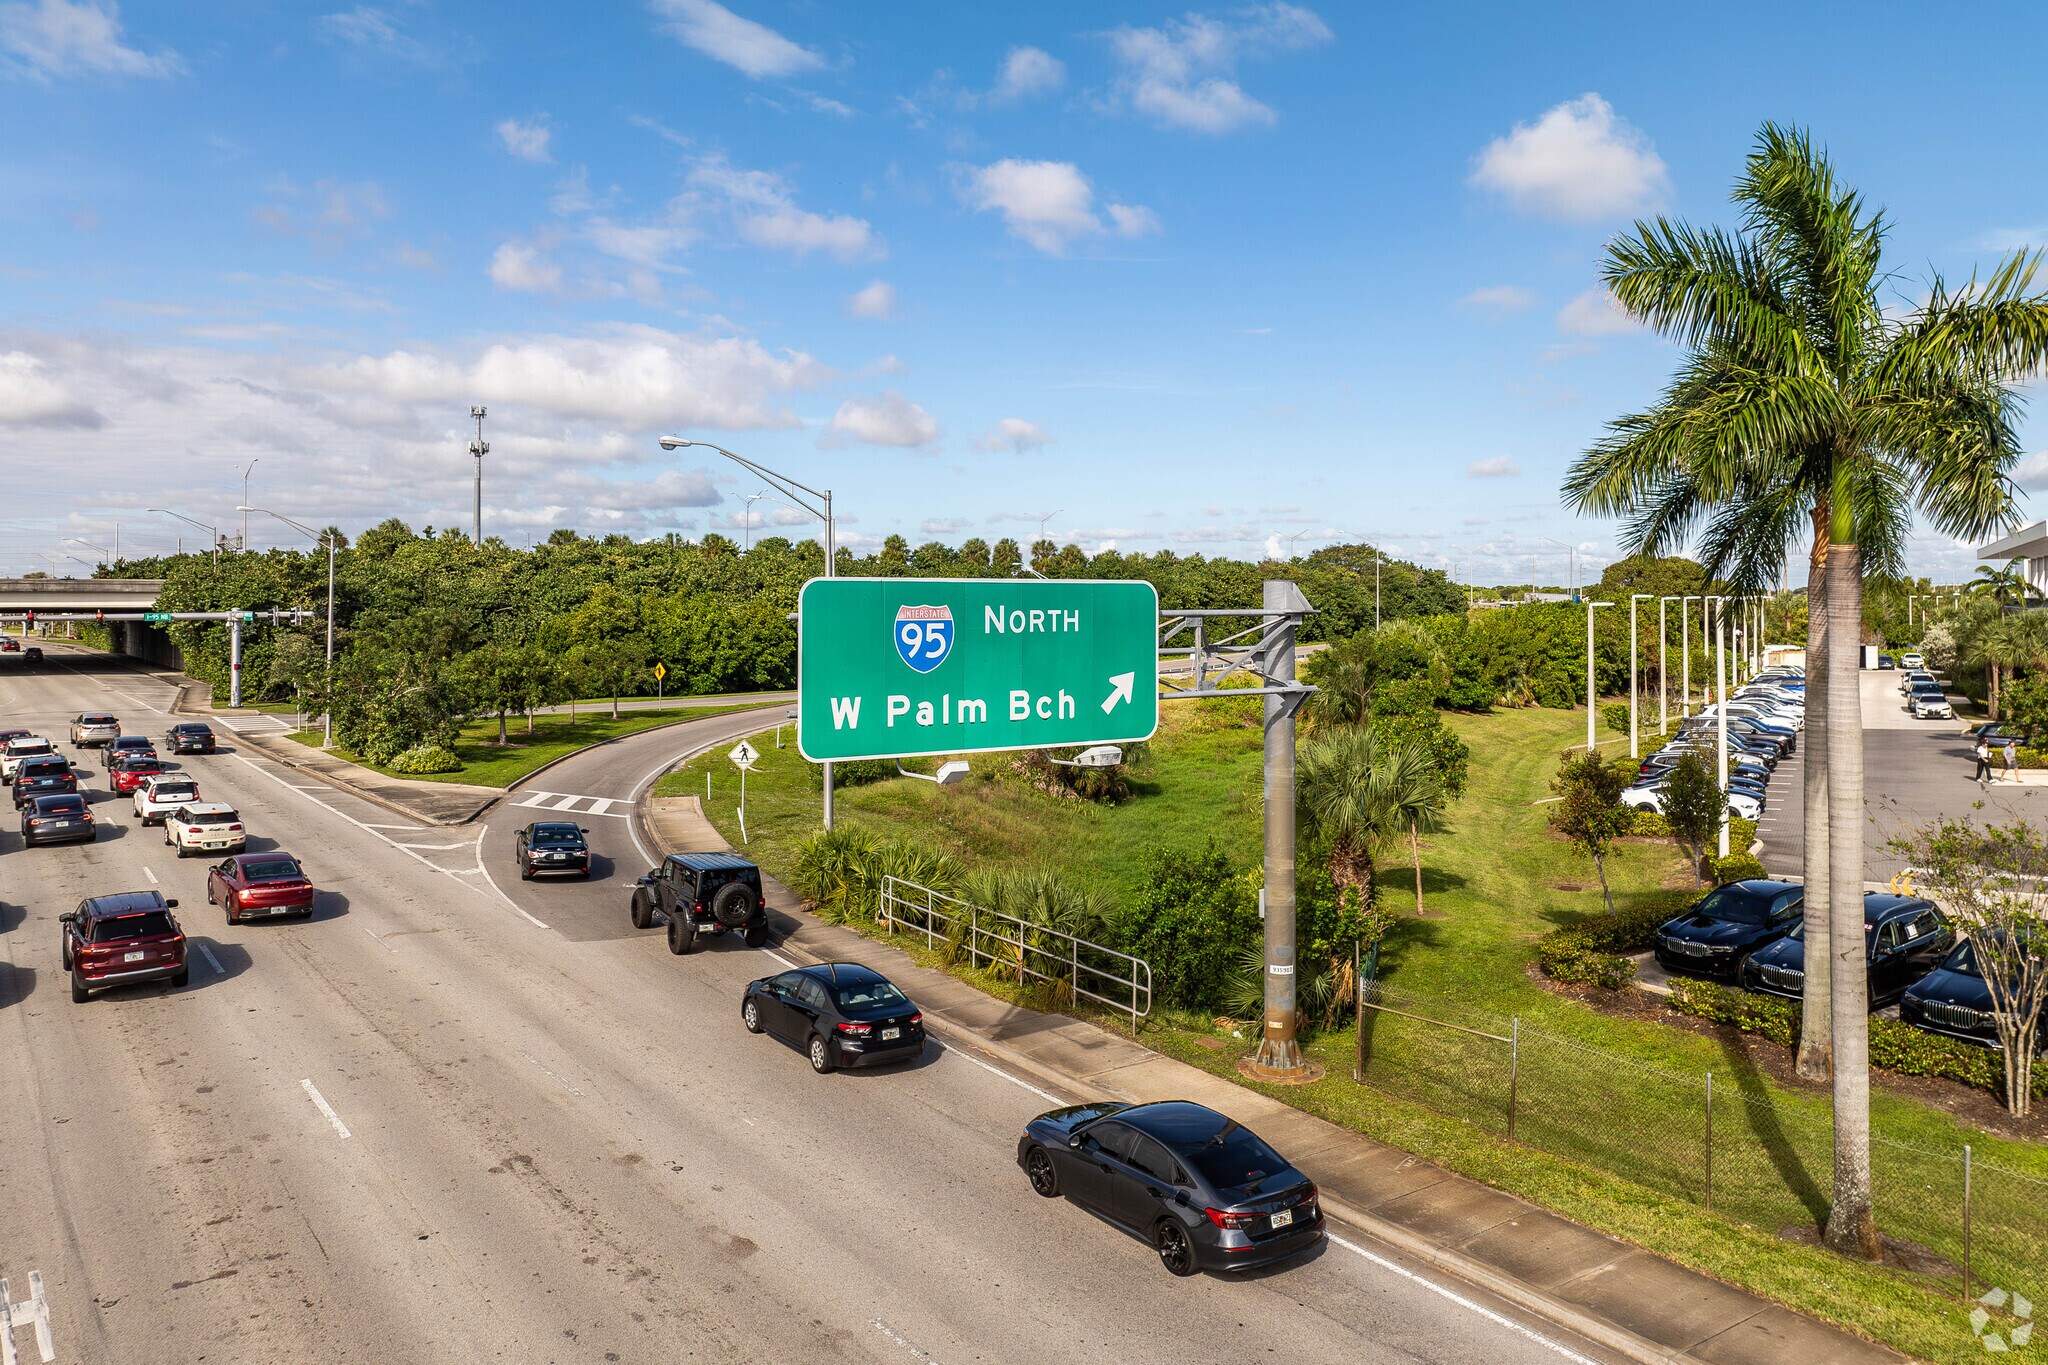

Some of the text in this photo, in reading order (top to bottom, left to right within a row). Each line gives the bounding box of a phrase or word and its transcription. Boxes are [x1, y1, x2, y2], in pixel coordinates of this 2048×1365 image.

[904, 610, 945, 619] INTERSTATE
[984, 605, 1079, 634] NORTH
[901, 622, 946, 659] 95
[830, 688, 1075, 730] W Palm Bch
